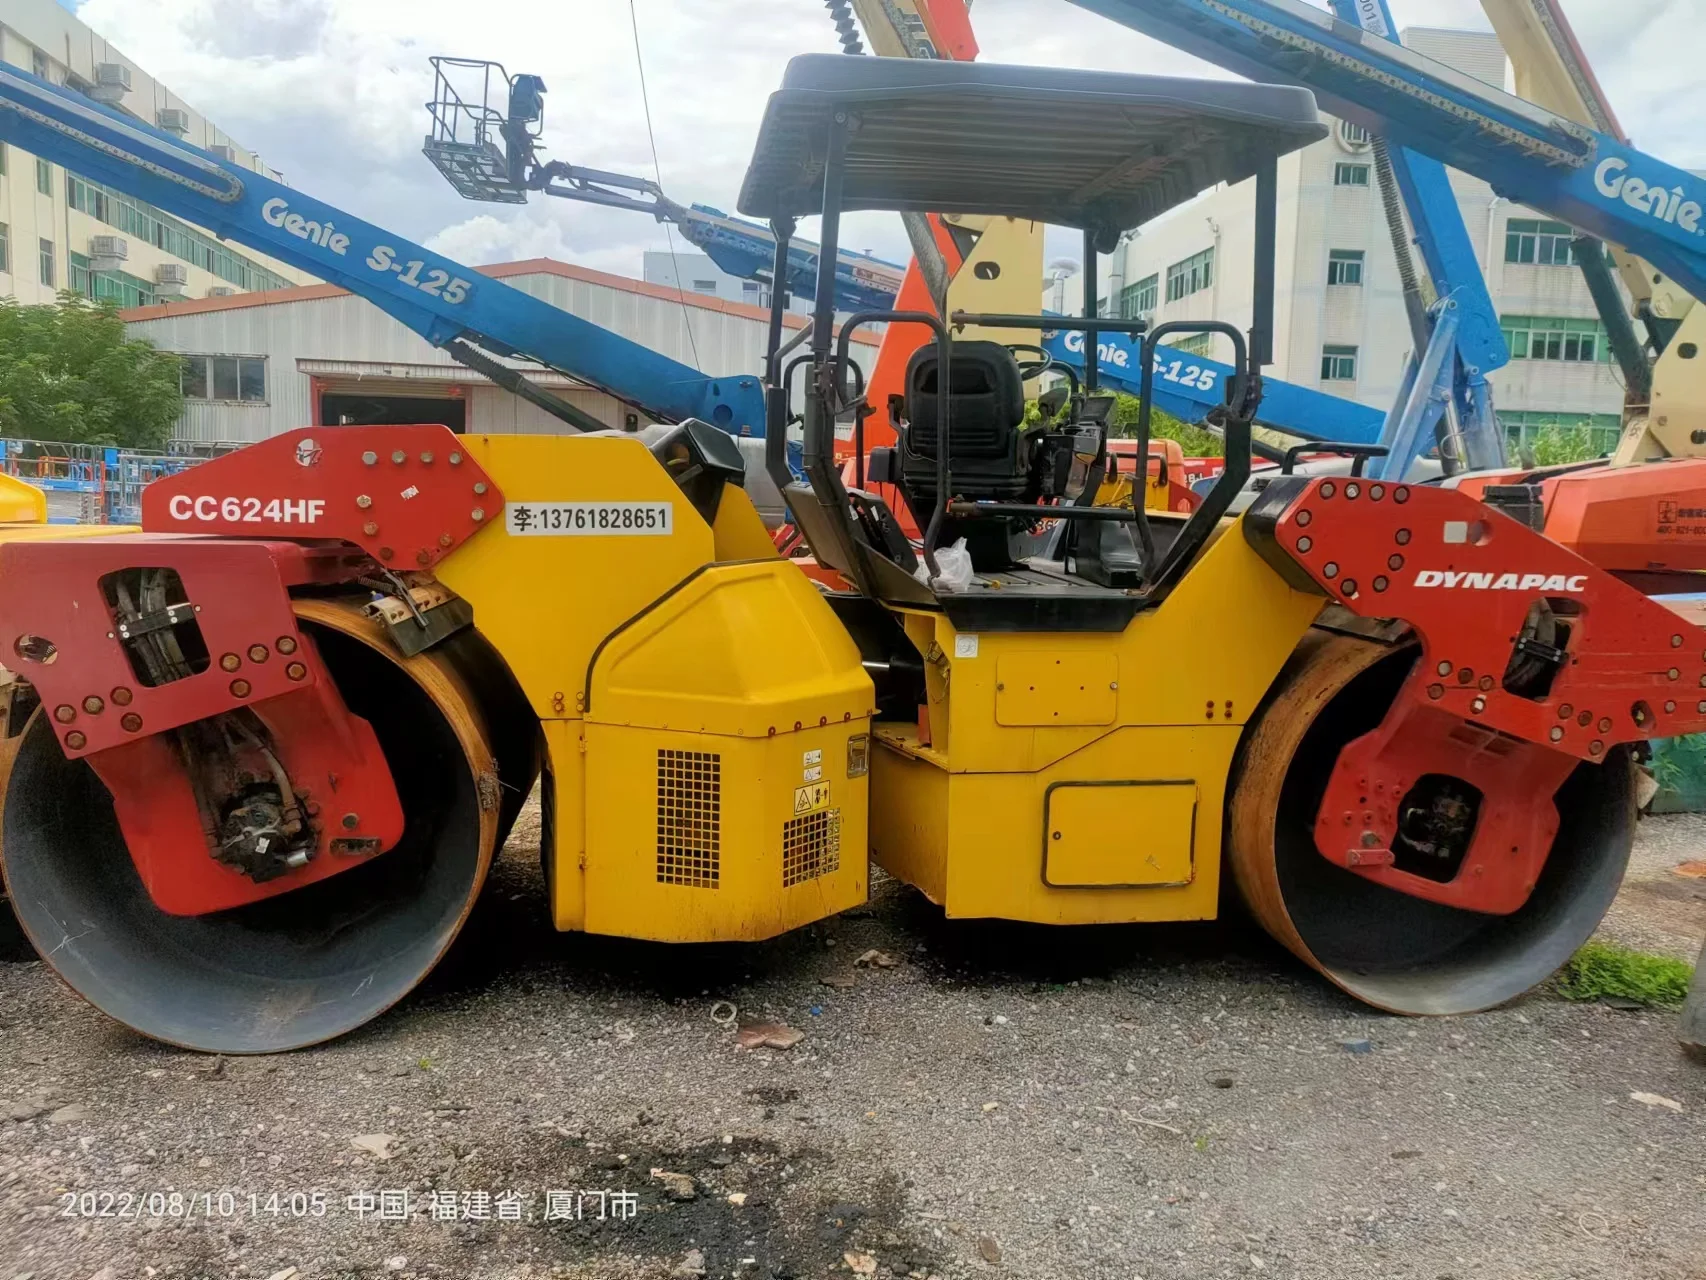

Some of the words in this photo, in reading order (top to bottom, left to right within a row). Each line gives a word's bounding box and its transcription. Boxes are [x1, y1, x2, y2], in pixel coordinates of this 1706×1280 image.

[1594, 157, 1702, 233] Genie
[262, 198, 350, 256] Genie
[366, 245, 473, 304] S-125
[169, 495, 325, 523] CC624HF
[514, 506, 666, 531] 李:13761828651
[1414, 570, 1588, 592] DYNAPAC
